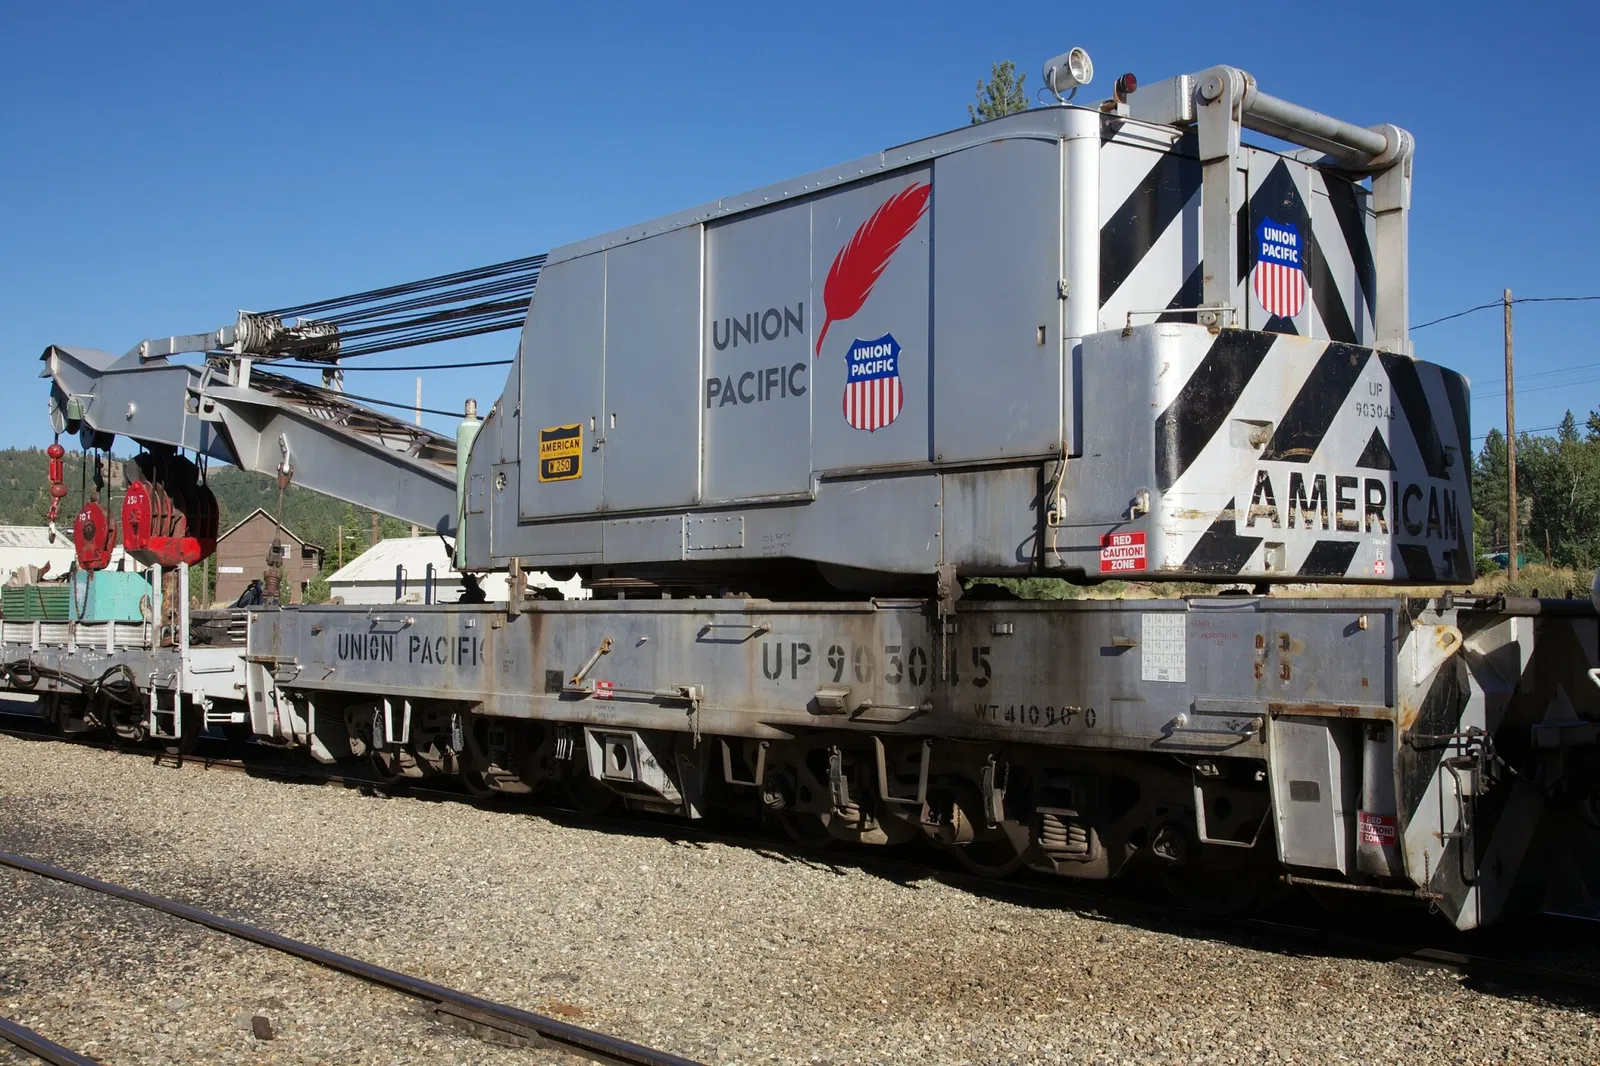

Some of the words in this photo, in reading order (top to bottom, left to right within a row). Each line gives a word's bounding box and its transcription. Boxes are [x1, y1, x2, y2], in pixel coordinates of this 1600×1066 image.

[1264, 227, 1296, 246] UNION
[1262, 242, 1298, 263] PACIFIC
[713, 302, 803, 351] UNION
[853, 343, 891, 361] UNION
[851, 358, 894, 376] PACIFIC
[706, 362, 807, 409] PACIFIC
[1369, 381, 1383, 397] UP
[541, 439, 580, 453] AMERICAN
[1246, 468, 1459, 541] AMERICAN
[1113, 535, 1132, 545] RED
[1103, 546, 1144, 558] CAUTION!
[1111, 559, 1135, 570] ZONE
[338, 633, 393, 662] UNION
[762, 642, 811, 680] UP
[974, 703, 999, 720] WT
[1366, 815, 1382, 824] RED
[1360, 823, 1393, 835] CAUTION!
[1364, 833, 1384, 843] ZONE
